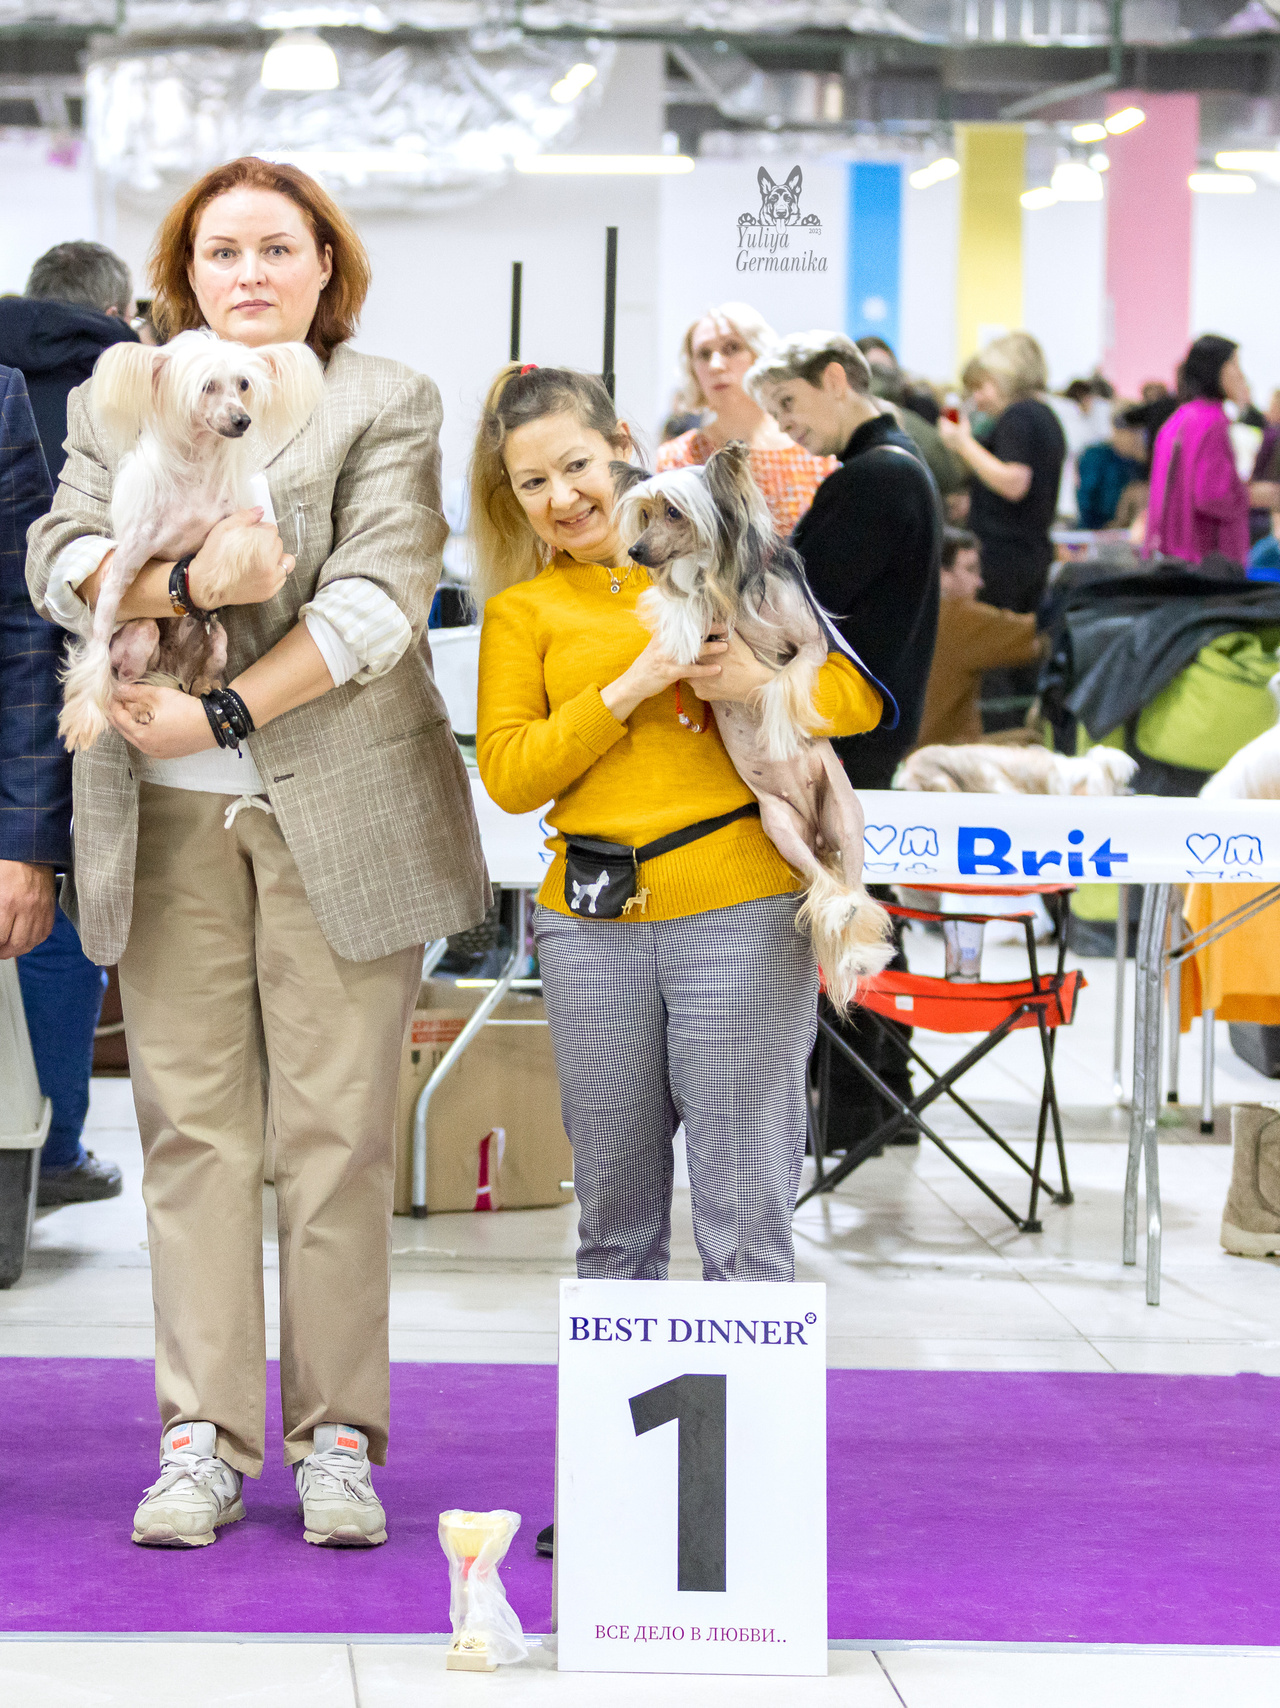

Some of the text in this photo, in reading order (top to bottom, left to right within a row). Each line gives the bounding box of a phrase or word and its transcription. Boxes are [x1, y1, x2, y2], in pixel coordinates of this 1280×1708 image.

[569, 1316, 808, 1345] BEST DINNER
[628, 1373, 727, 1592] 1
[595, 1624, 787, 1643] ВСЕ ДЕЛО В ЛЮБВИ..
